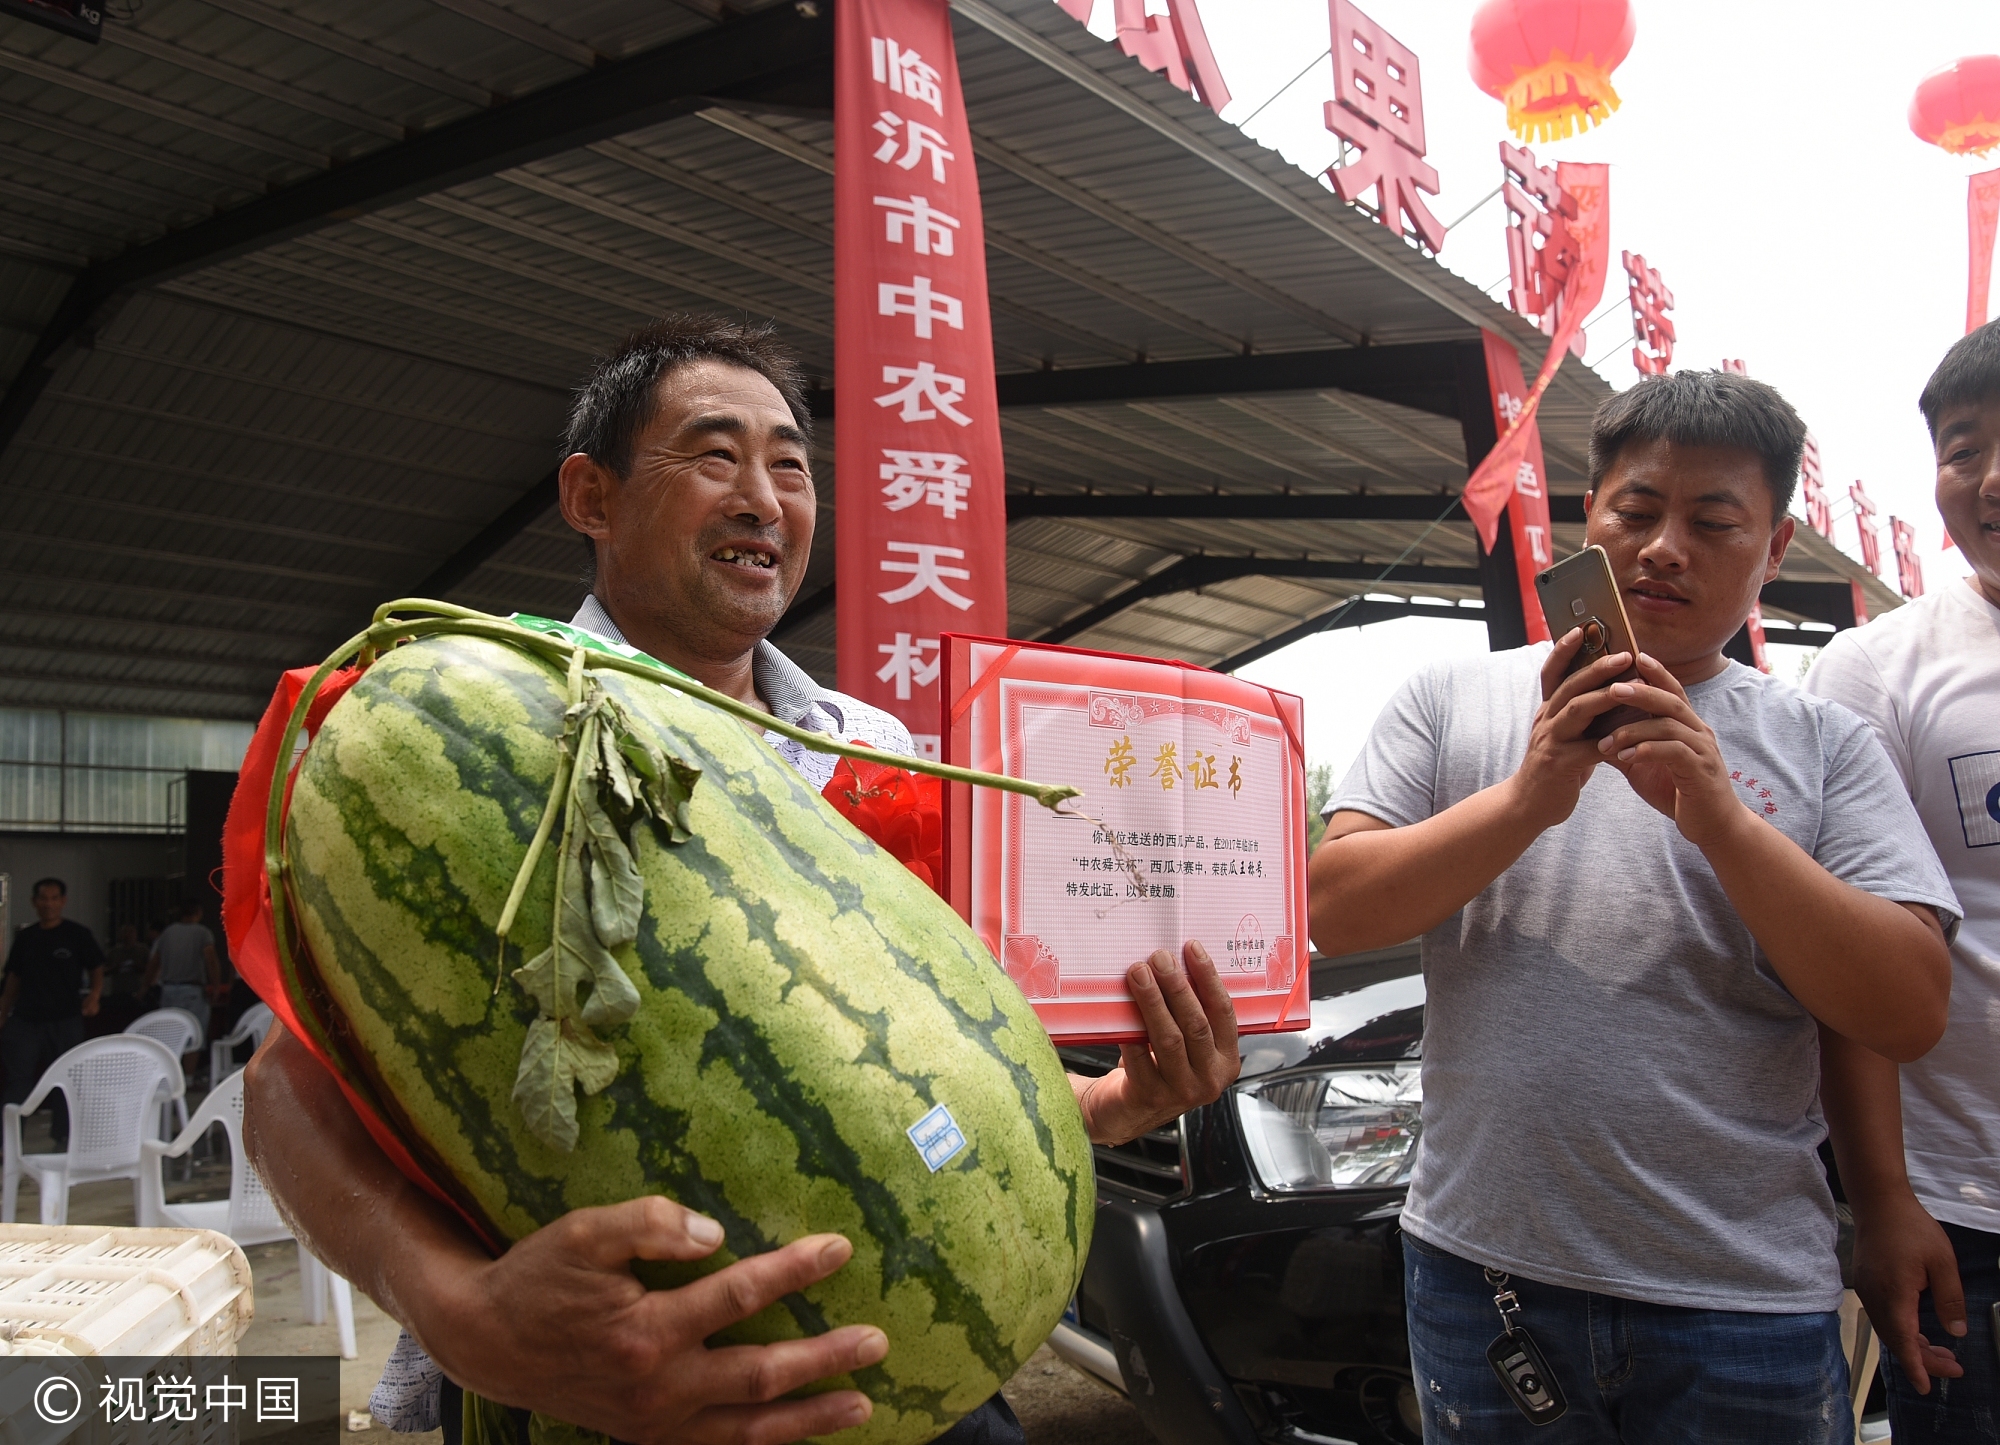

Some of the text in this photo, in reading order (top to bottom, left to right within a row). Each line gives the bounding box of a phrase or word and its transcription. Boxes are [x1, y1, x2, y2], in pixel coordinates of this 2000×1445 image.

[81, 3, 100, 25] kg
[871, 36, 976, 764] 临沂市中农舜天杯
[1103, 735, 1243, 800] 荣誉证书
